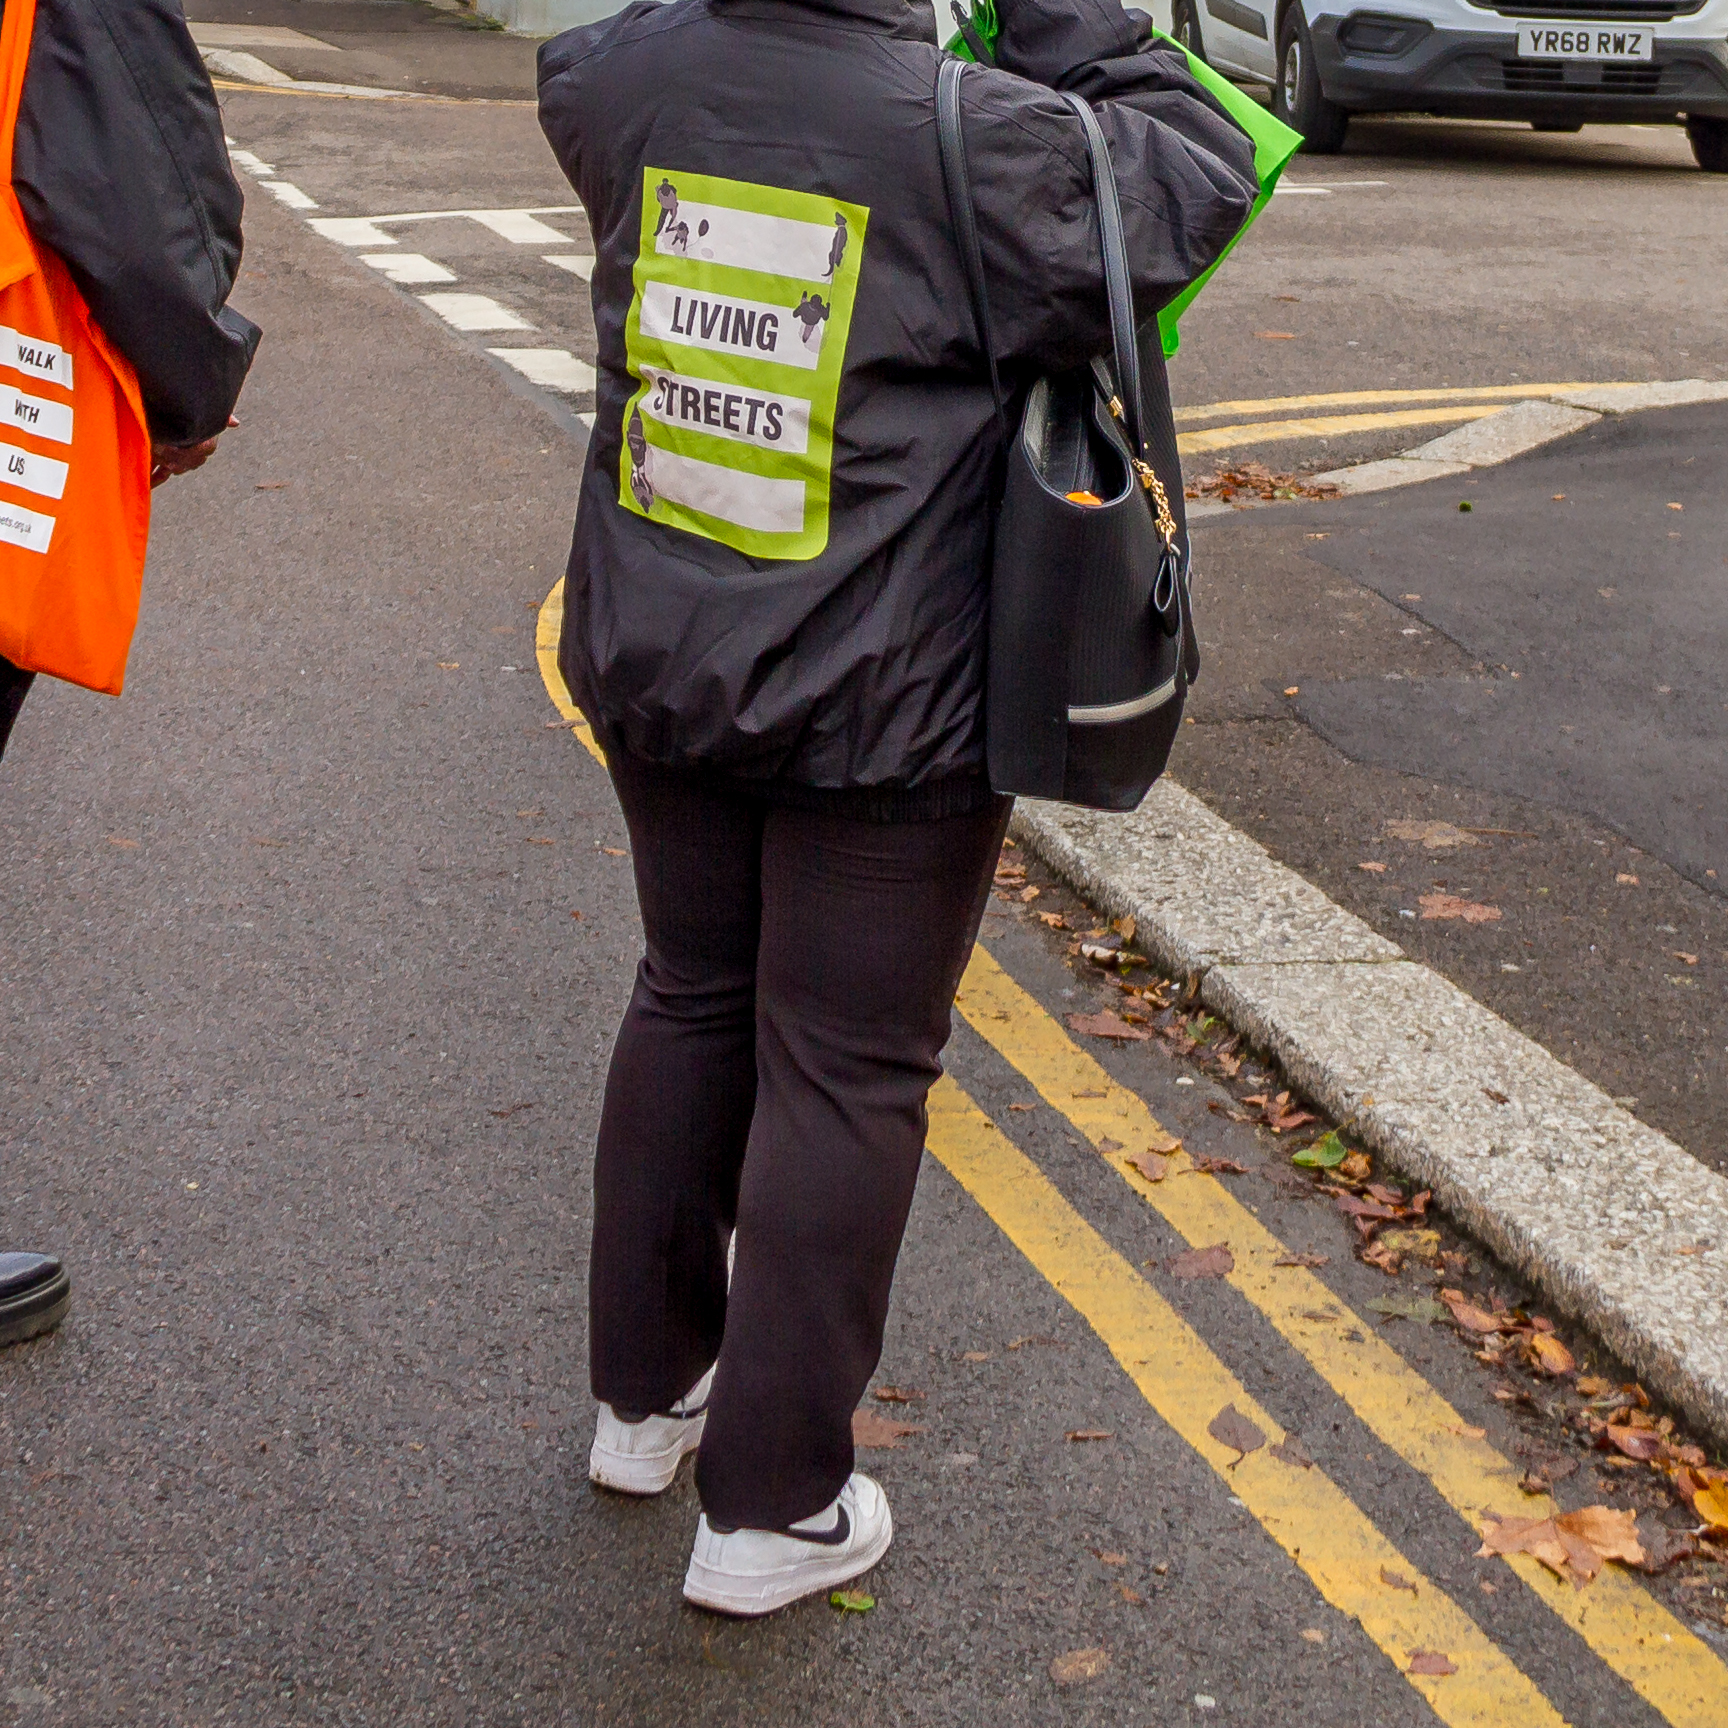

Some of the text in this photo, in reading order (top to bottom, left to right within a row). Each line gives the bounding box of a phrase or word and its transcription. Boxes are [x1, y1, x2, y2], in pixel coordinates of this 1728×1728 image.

[1530, 29, 1643, 55] YR68 RWZ
[670, 296, 779, 352] LIVING
[16, 343, 57, 371] WALK
[653, 376, 783, 441] STREETS
[7, 454, 26, 476] US
